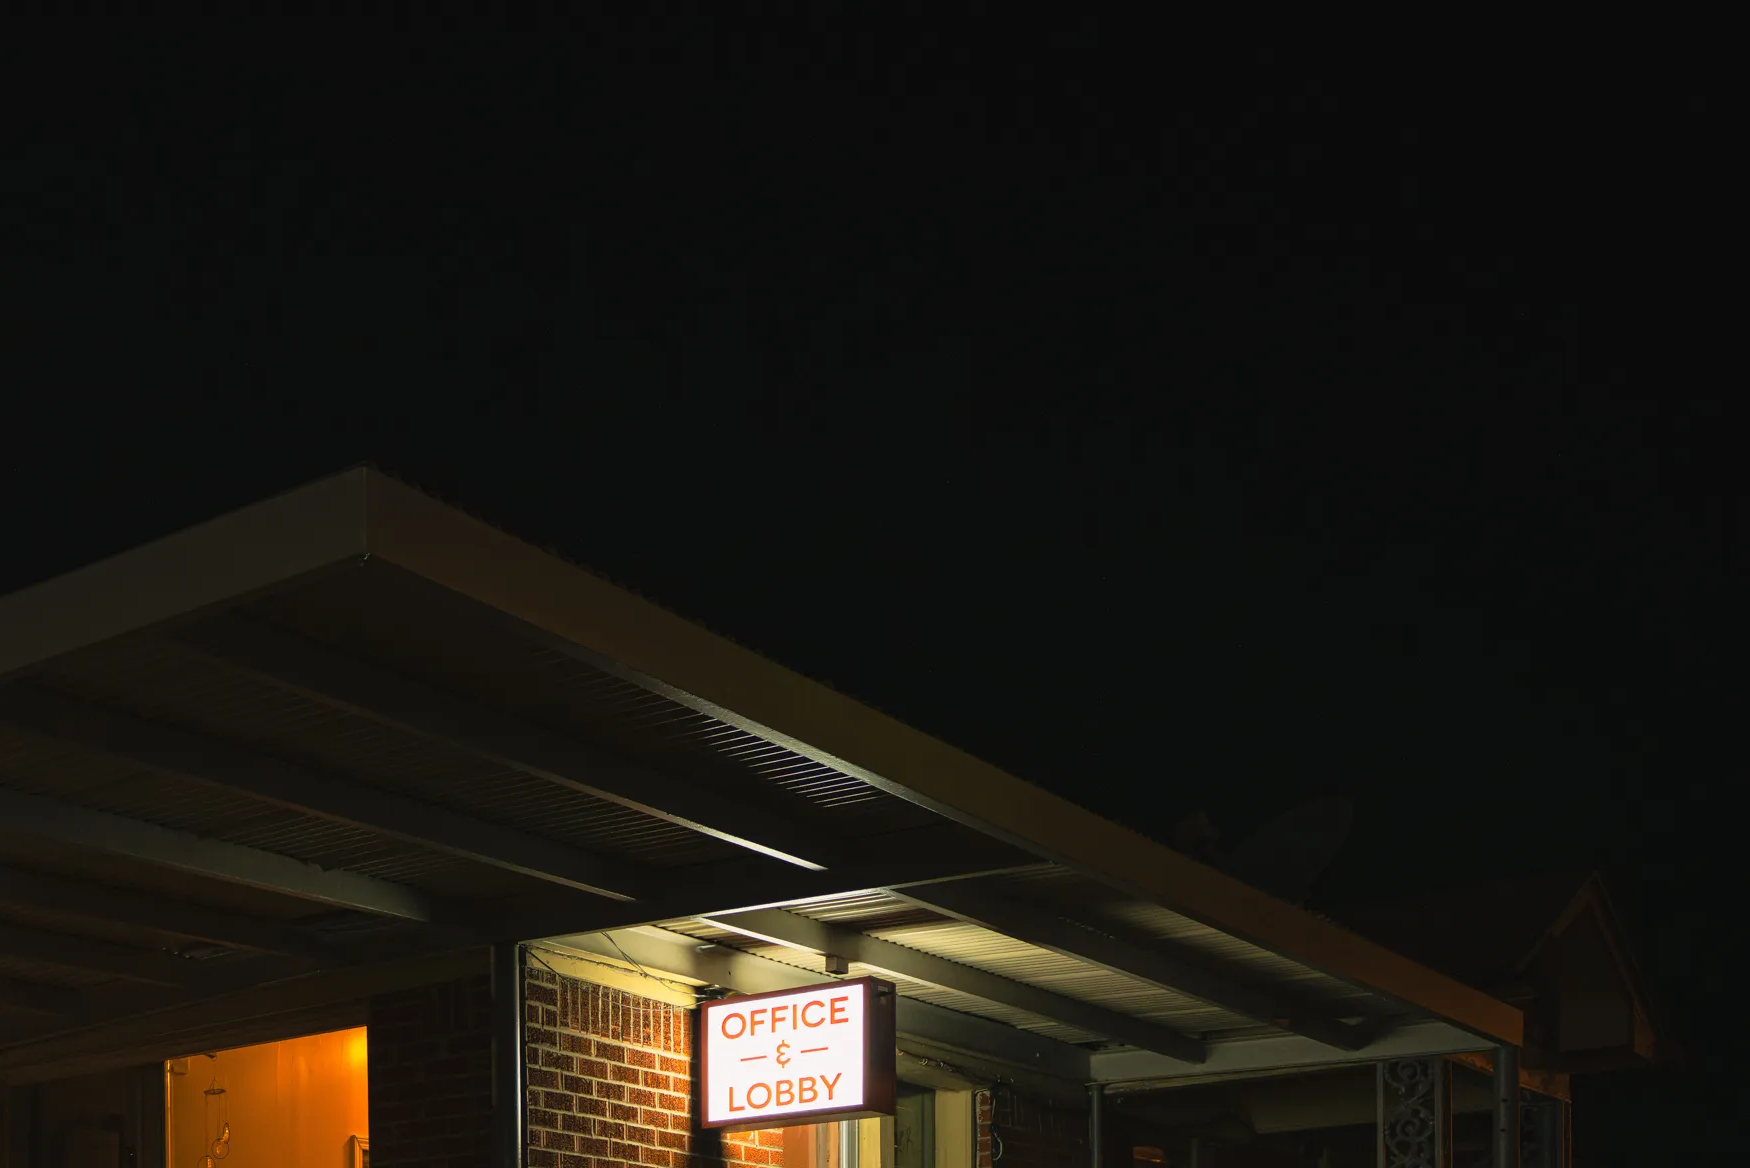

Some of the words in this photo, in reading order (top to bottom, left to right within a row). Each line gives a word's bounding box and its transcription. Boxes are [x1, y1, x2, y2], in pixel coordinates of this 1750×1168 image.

[721, 996, 849, 1039] OFFICE
[776, 1039, 791, 1068] &
[728, 1072, 842, 1112] LOBBY
